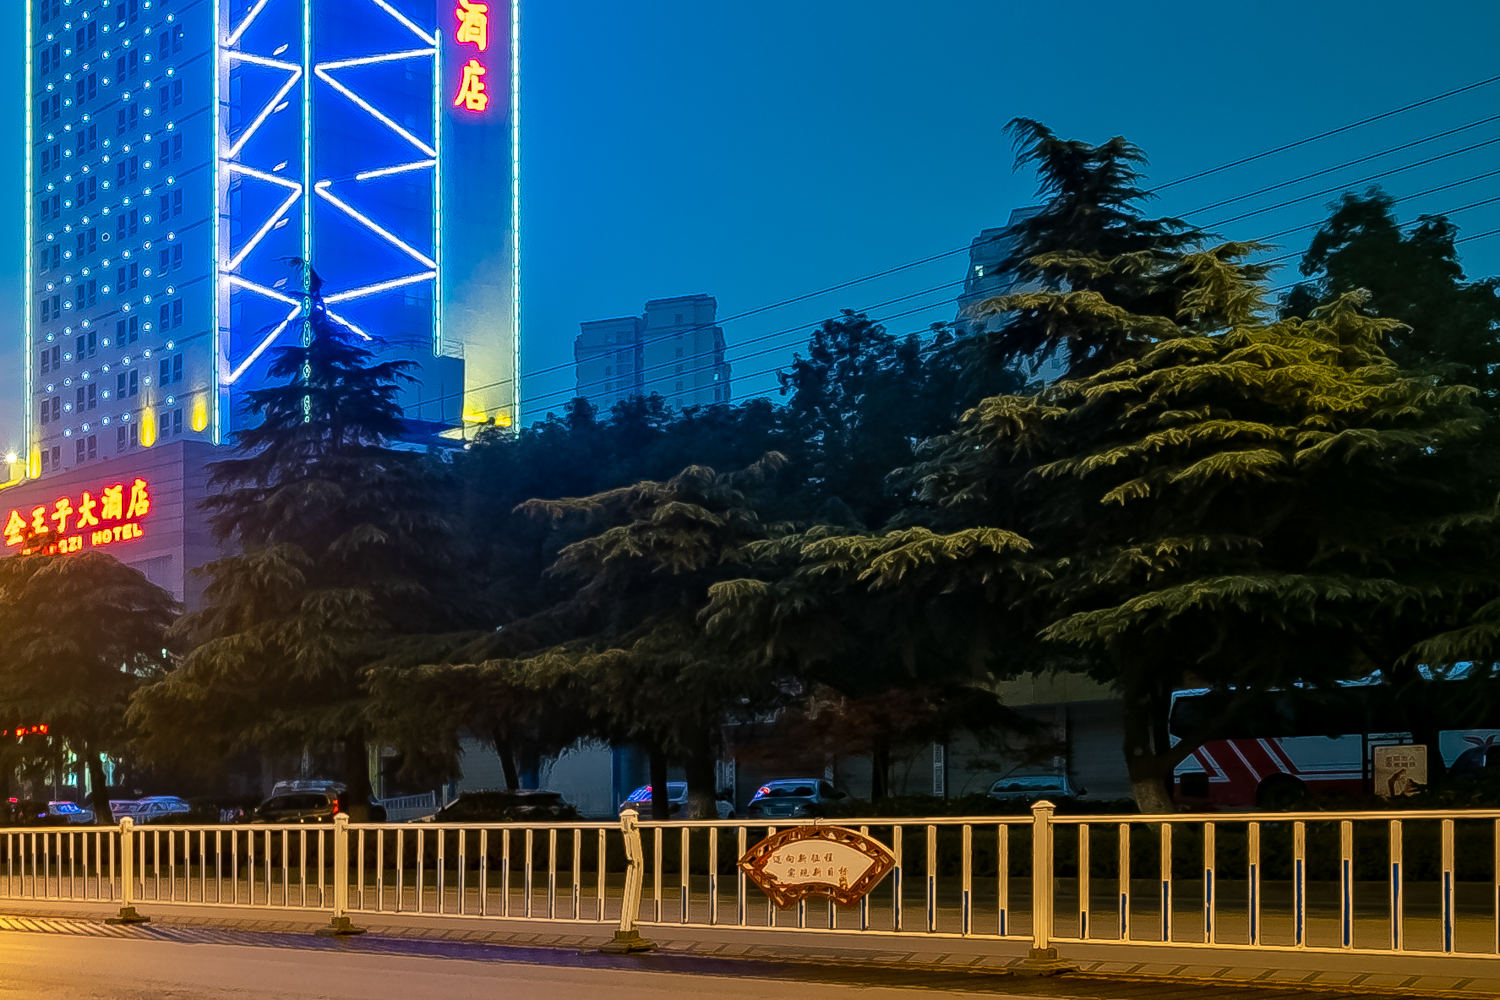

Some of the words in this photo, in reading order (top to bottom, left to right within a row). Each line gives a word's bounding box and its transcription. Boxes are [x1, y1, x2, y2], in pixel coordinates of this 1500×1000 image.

[4, 478, 150, 546] 金王子大酒店
[91, 522, 143, 546] HOTEL
[772, 852, 833, 864] 迈向新征程
